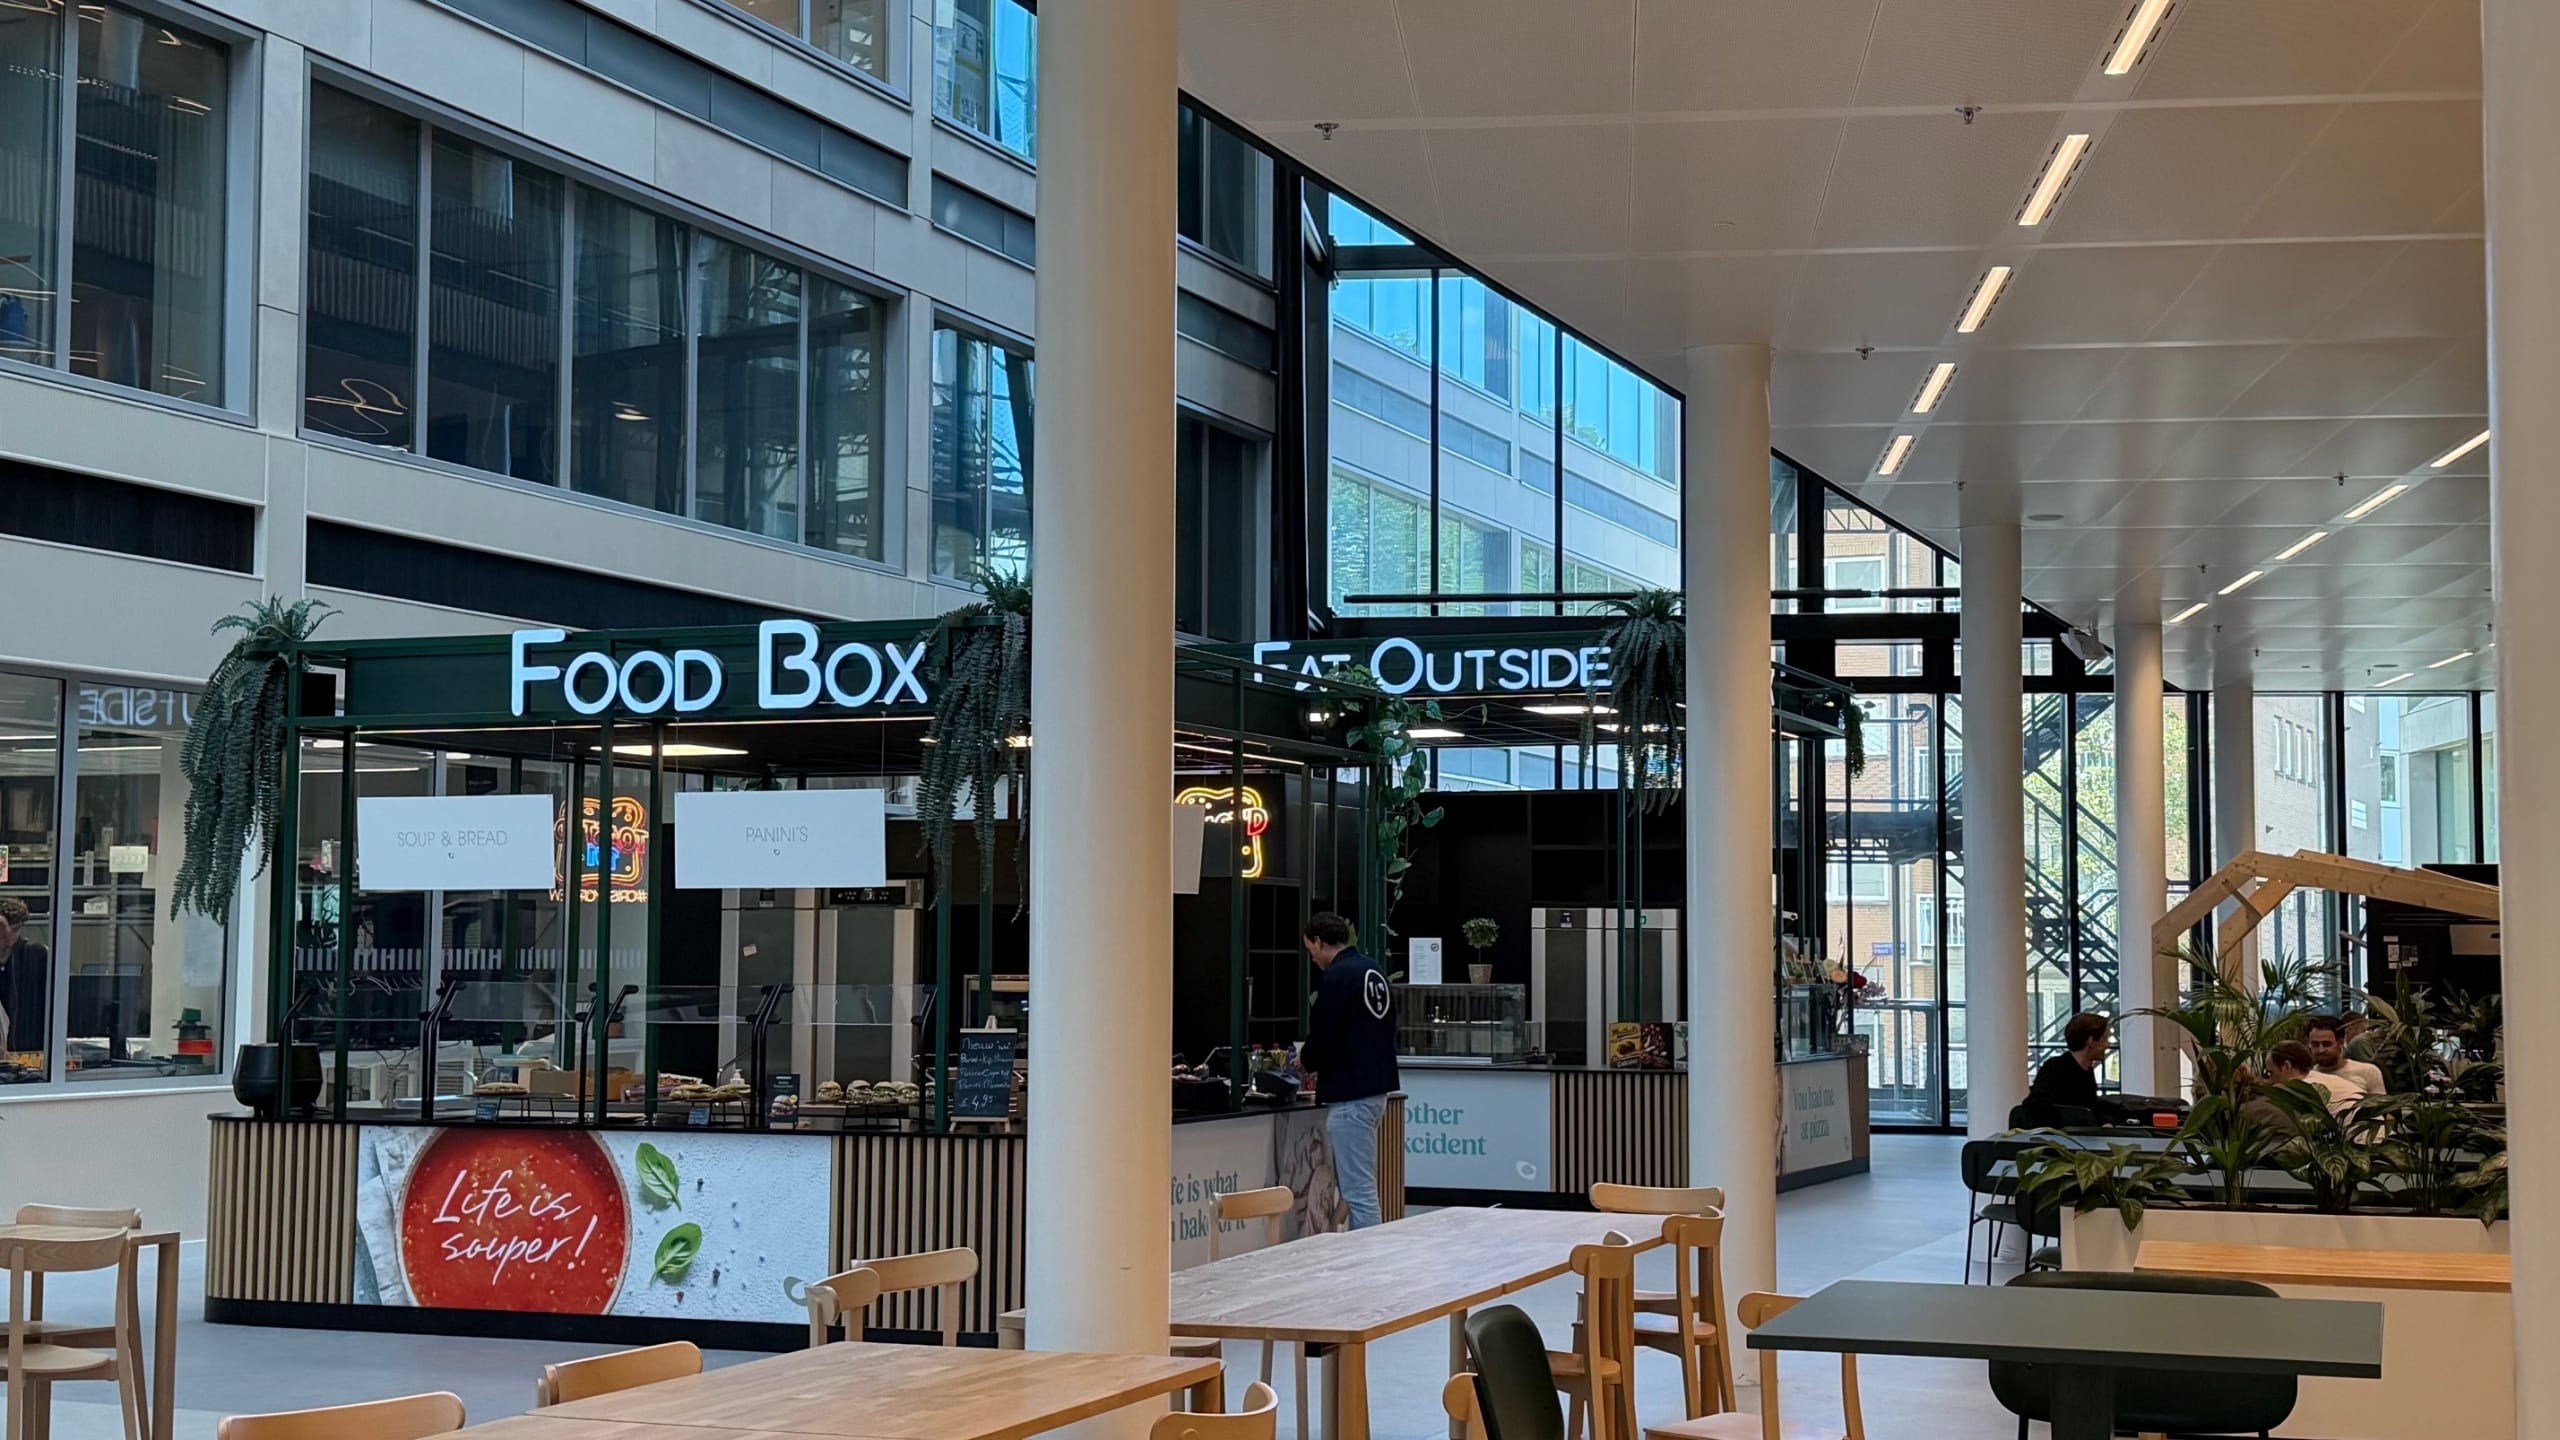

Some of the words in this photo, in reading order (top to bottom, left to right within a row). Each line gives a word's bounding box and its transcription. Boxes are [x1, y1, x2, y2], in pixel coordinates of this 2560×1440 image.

[511, 629, 723, 717] FOOD
[758, 619, 929, 710] BOX
[1370, 637, 1613, 695] OUTSIDE
[397, 831, 436, 847] SOUP
[441, 832, 452, 847] &
[458, 830, 508, 847] BREAD
[745, 826, 809, 843] PANINI'S
[1404, 1132, 1487, 1155] xcident
[432, 1169, 522, 1226] Life
[529, 1182, 582, 1221] is
[1187, 1173, 1200, 1202] is
[1203, 1169, 1238, 1199] what
[1180, 1208, 1209, 1240] bak
[441, 1214, 598, 1286] souper!
